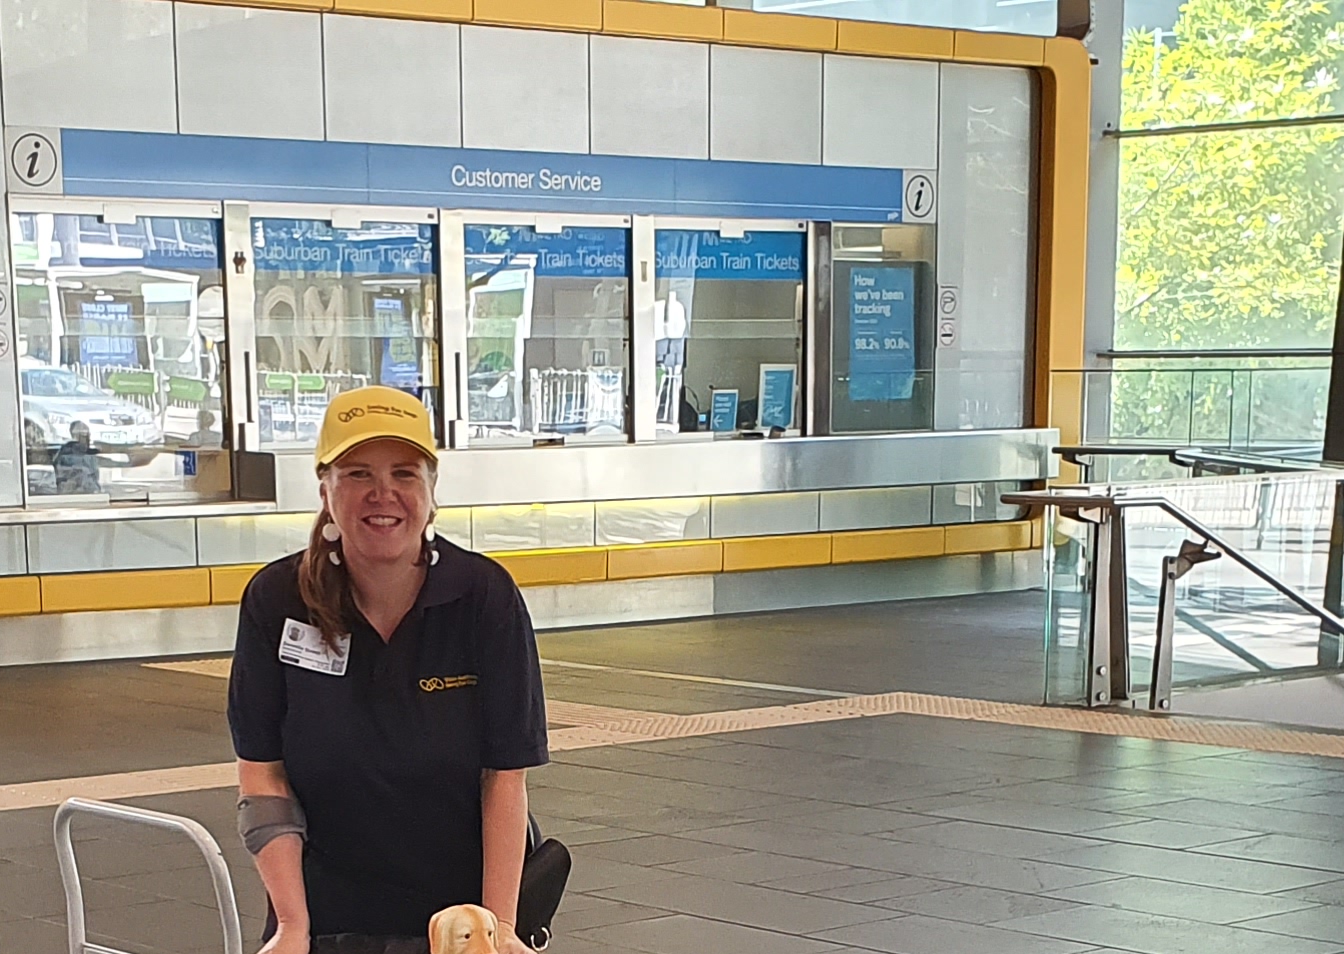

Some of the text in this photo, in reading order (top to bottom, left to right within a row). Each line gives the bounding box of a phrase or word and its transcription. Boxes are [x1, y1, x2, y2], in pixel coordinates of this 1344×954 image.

[451, 164, 602, 192] Customer Service
[254, 243, 330, 262] Suburban
[335, 243, 373, 263] Train
[539, 248, 572, 267] Train
[576, 249, 625, 268] Tickets
[656, 251, 799, 271] Suburban Train Tickets
[854, 275, 875, 286] How
[882, 288, 904, 300] been
[855, 303, 892, 317] tracking
